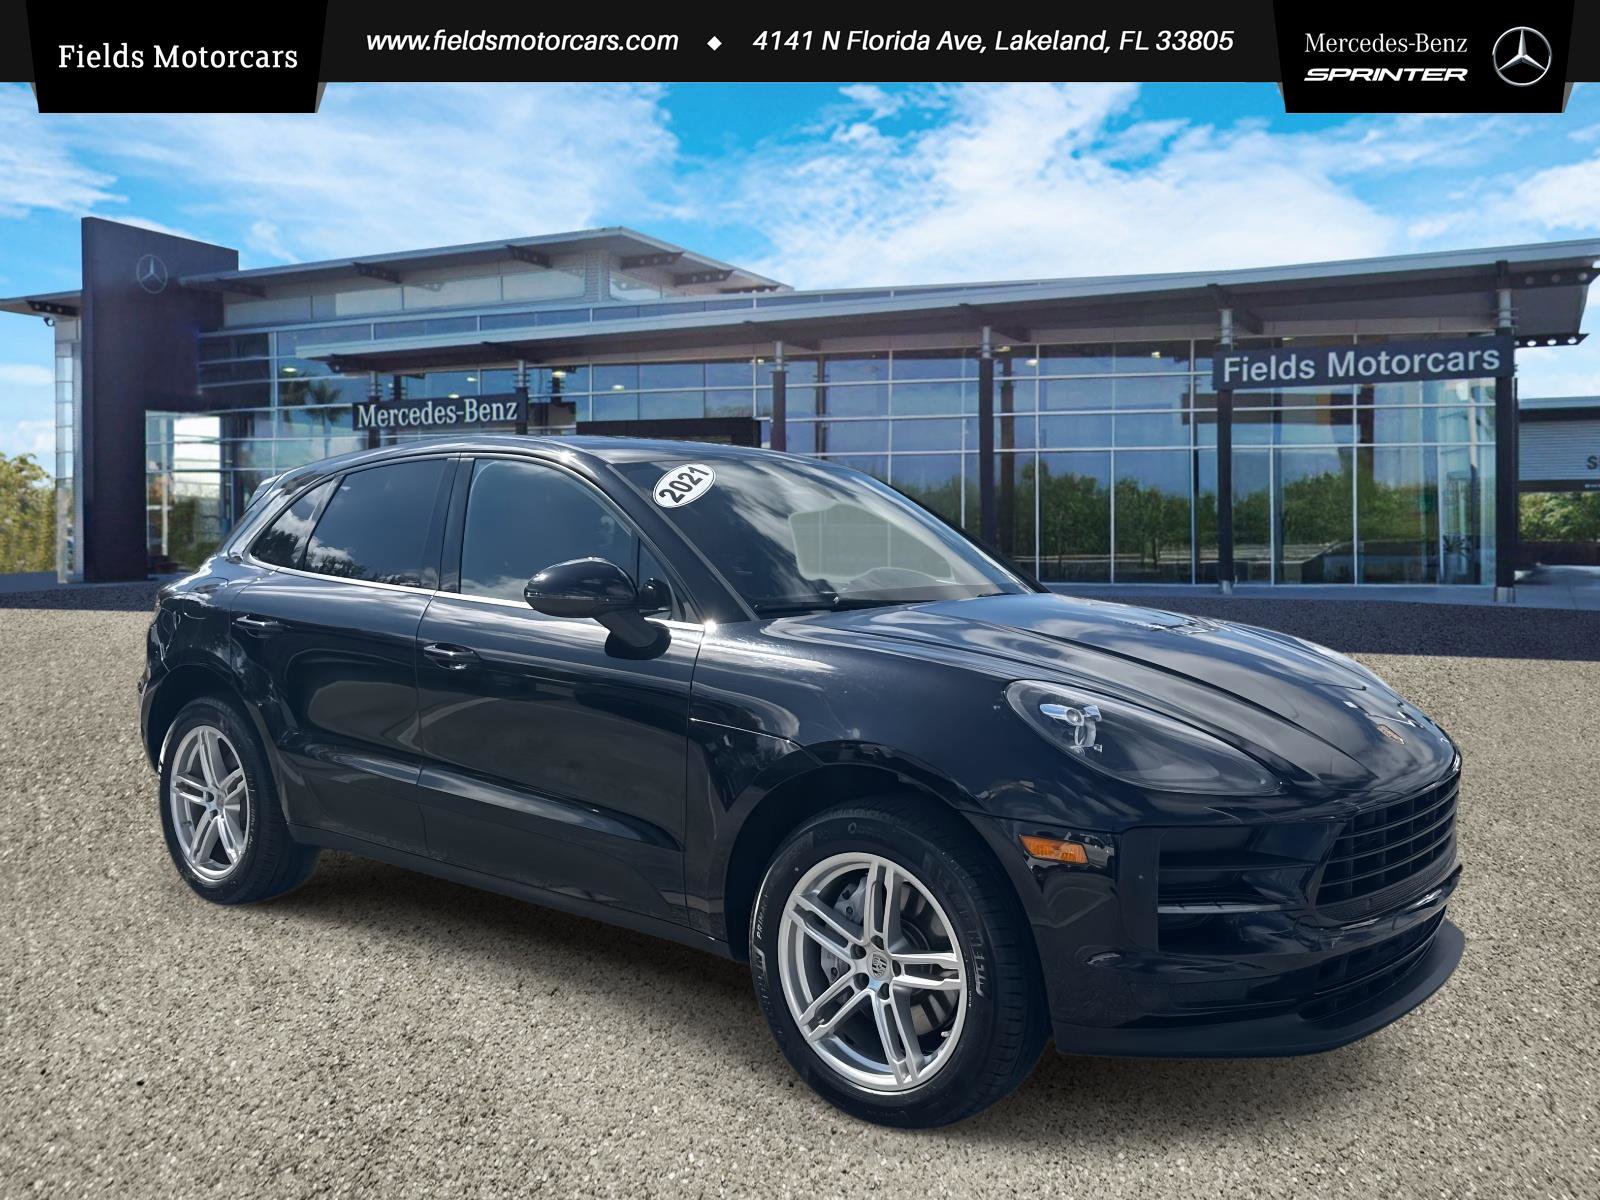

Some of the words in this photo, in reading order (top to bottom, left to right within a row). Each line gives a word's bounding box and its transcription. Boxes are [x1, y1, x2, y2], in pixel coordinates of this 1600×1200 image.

[1223, 353, 1316, 383] Fields
[1327, 348, 1501, 378] Motorcars
[356, 398, 519, 429] Mercedes-Benz
[658, 465, 712, 504] 2021
